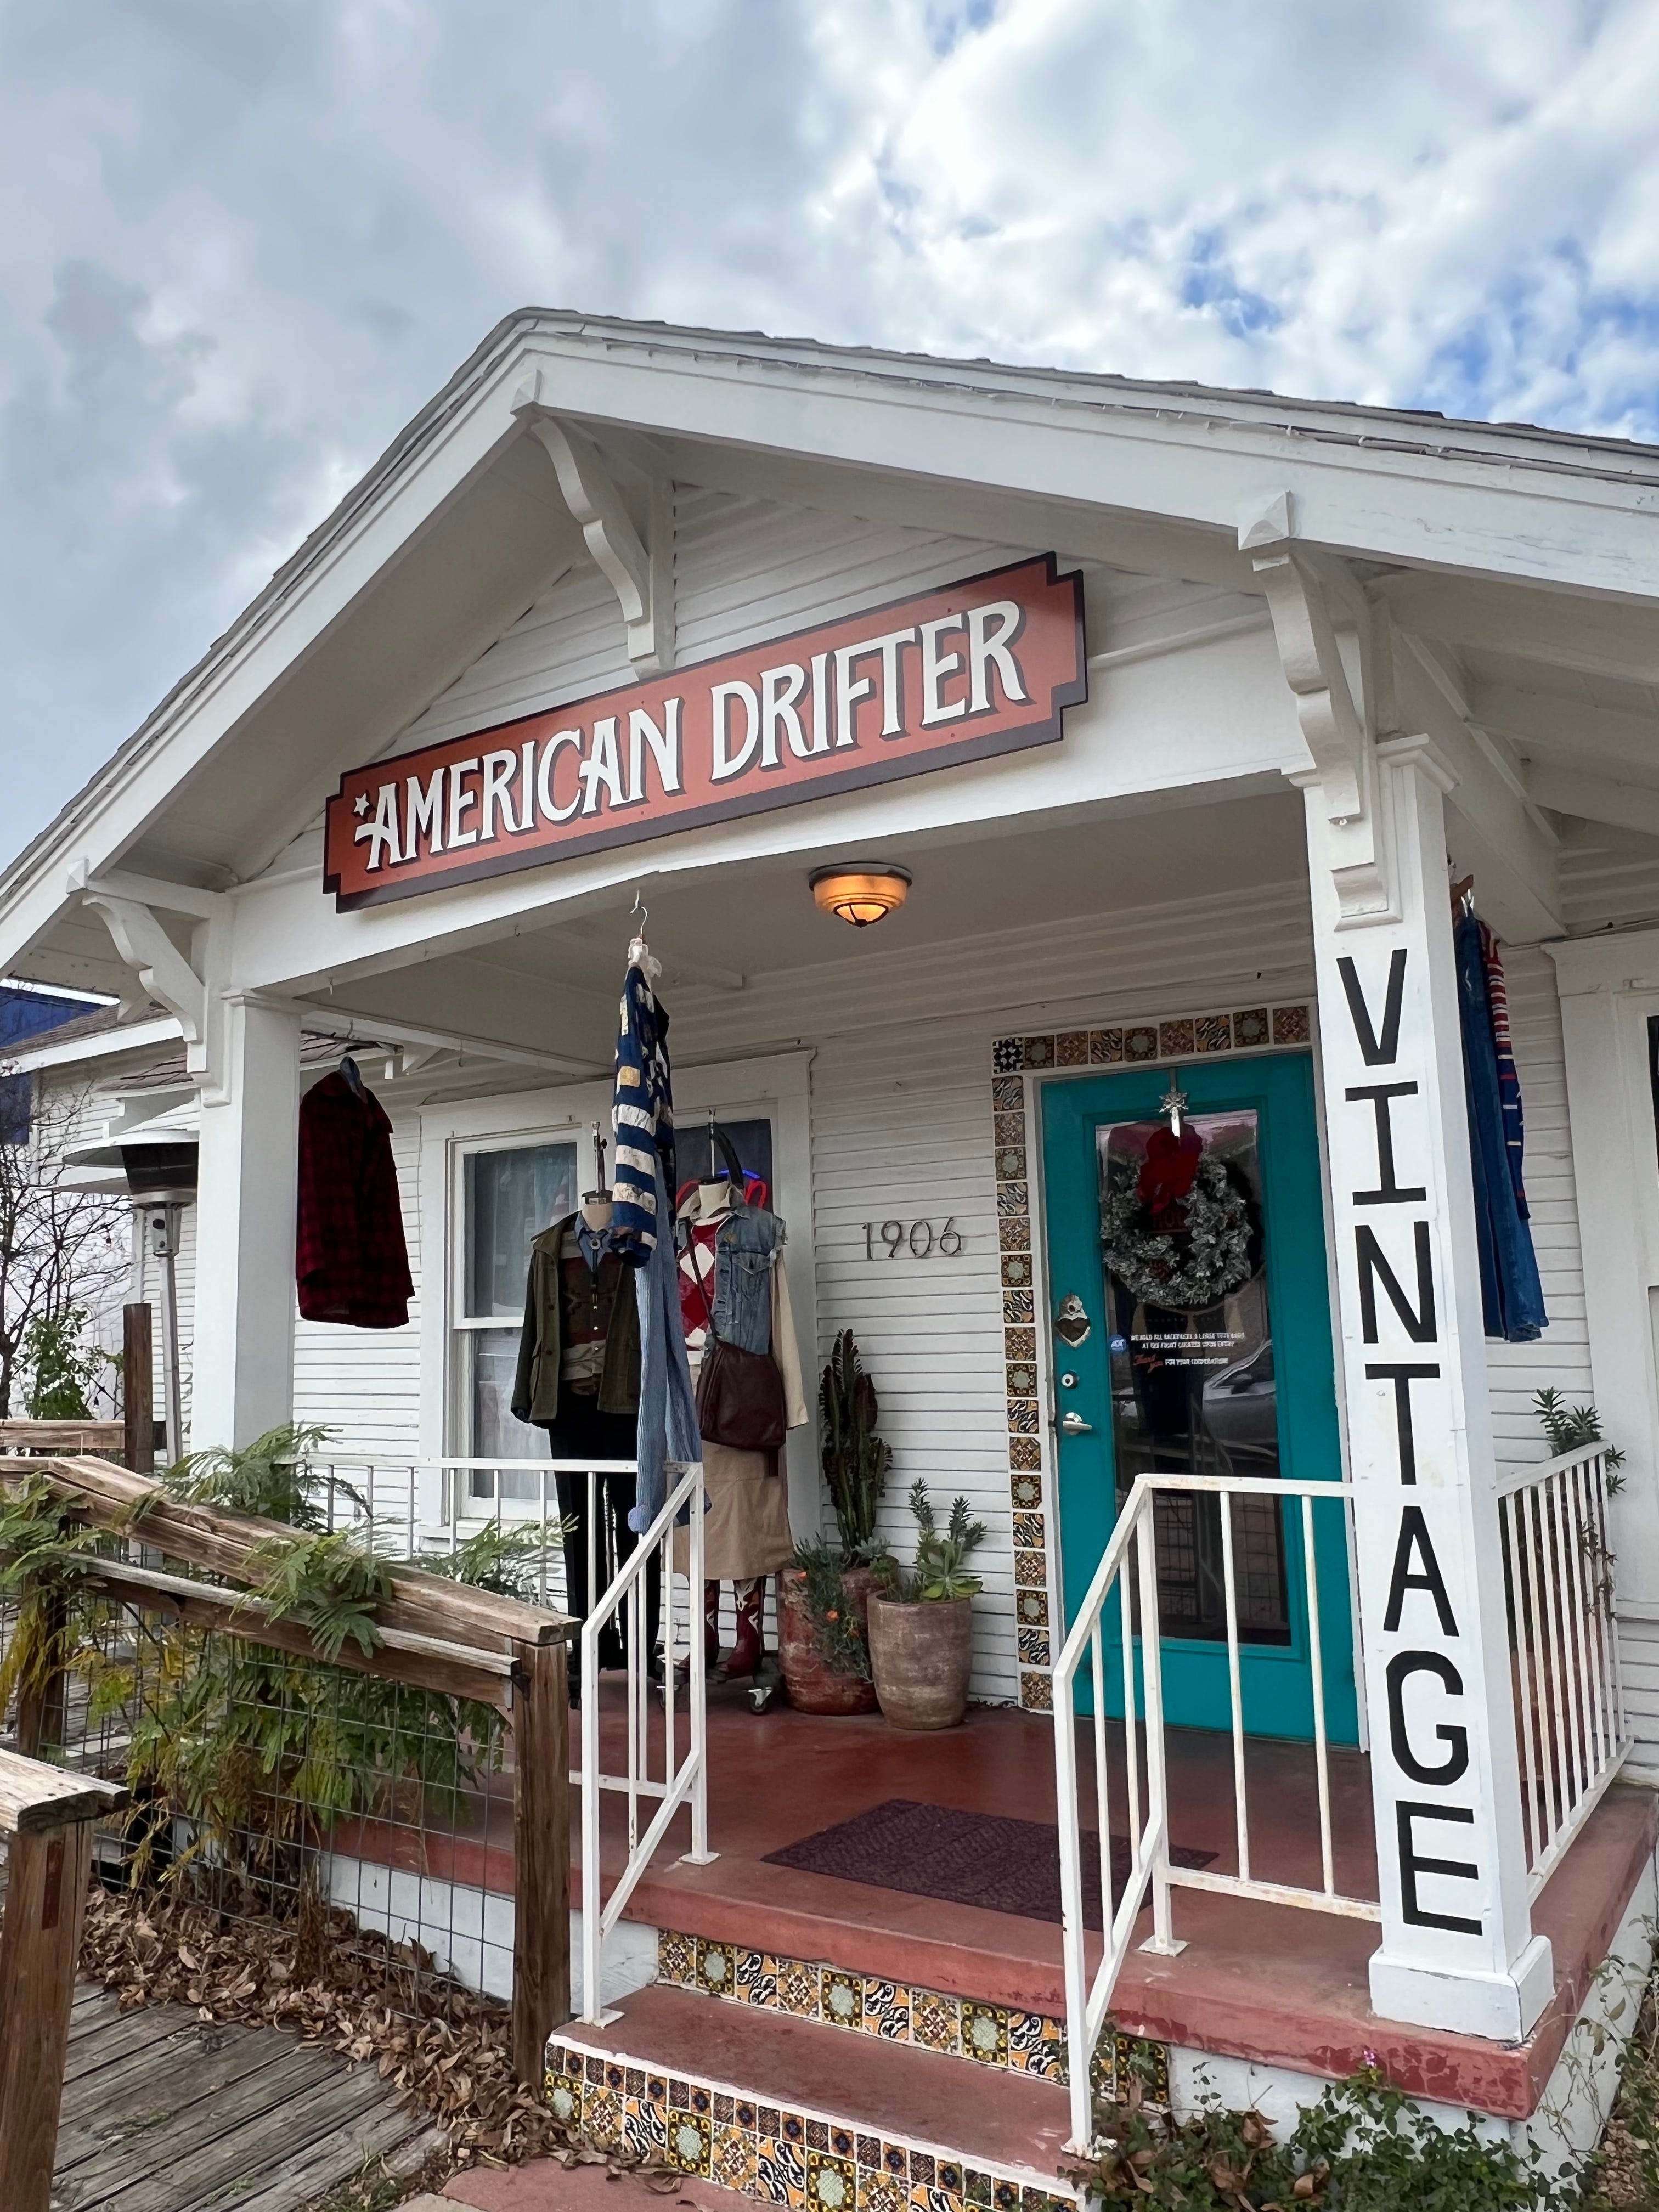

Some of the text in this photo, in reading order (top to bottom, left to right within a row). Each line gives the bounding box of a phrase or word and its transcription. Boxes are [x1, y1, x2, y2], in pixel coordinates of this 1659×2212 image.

[354, 600, 1028, 871] AMERICAN DRIFTER
[862, 1216, 962, 1260] 1906
[1336, 948, 1483, 1937] VINTAGE
